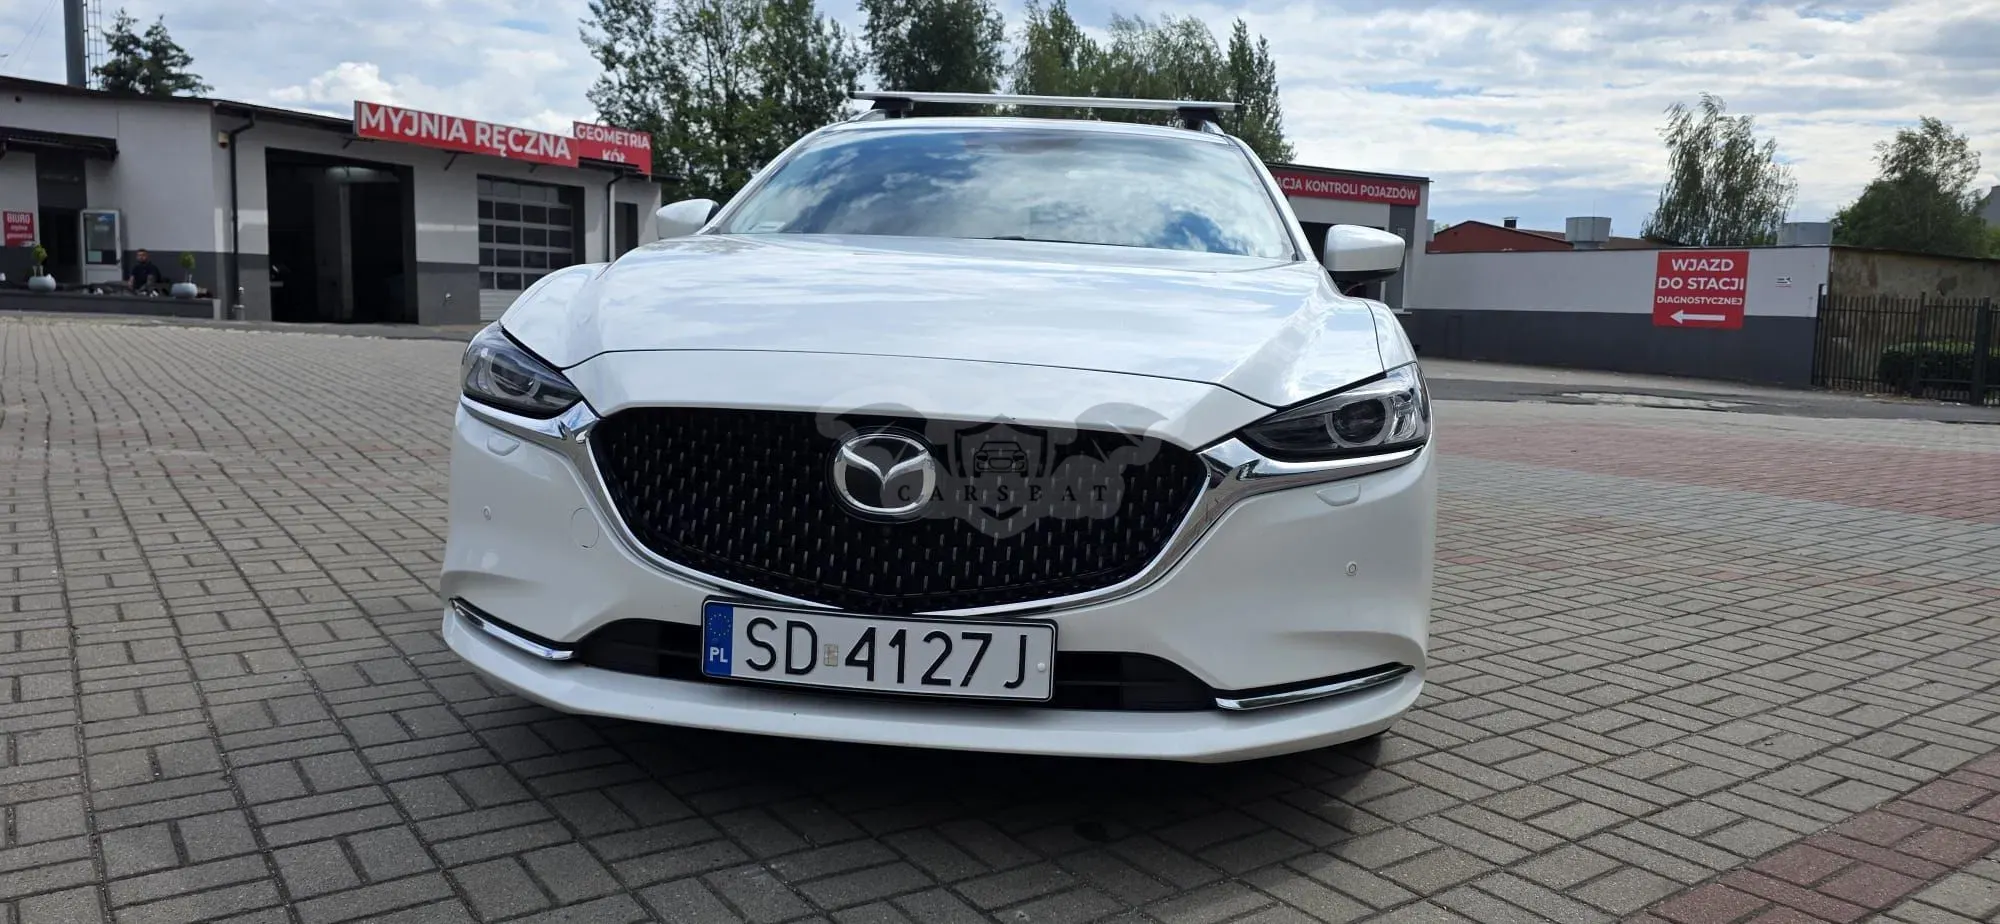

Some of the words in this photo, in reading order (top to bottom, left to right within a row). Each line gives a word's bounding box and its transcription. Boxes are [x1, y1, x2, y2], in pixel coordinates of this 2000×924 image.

[360, 103, 469, 144] MYJNIA
[474, 121, 572, 161] RĘCZNA
[575, 124, 651, 150] GEOMETRIA
[1275, 176, 1302, 190] ACJA
[1305, 179, 1358, 195] KONTROLI
[1361, 184, 1417, 200] POJAZDÓW
[1671, 258, 1734, 272] WJAZD
[1658, 277, 1683, 290] DO
[1687, 278, 1744, 291] STACJI
[1656, 296, 1743, 306] DIAGNOSTYCZNEJ
[709, 646, 729, 664] PL
[745, 616, 818, 676] SD
[845, 626, 1028, 690] 4127J
